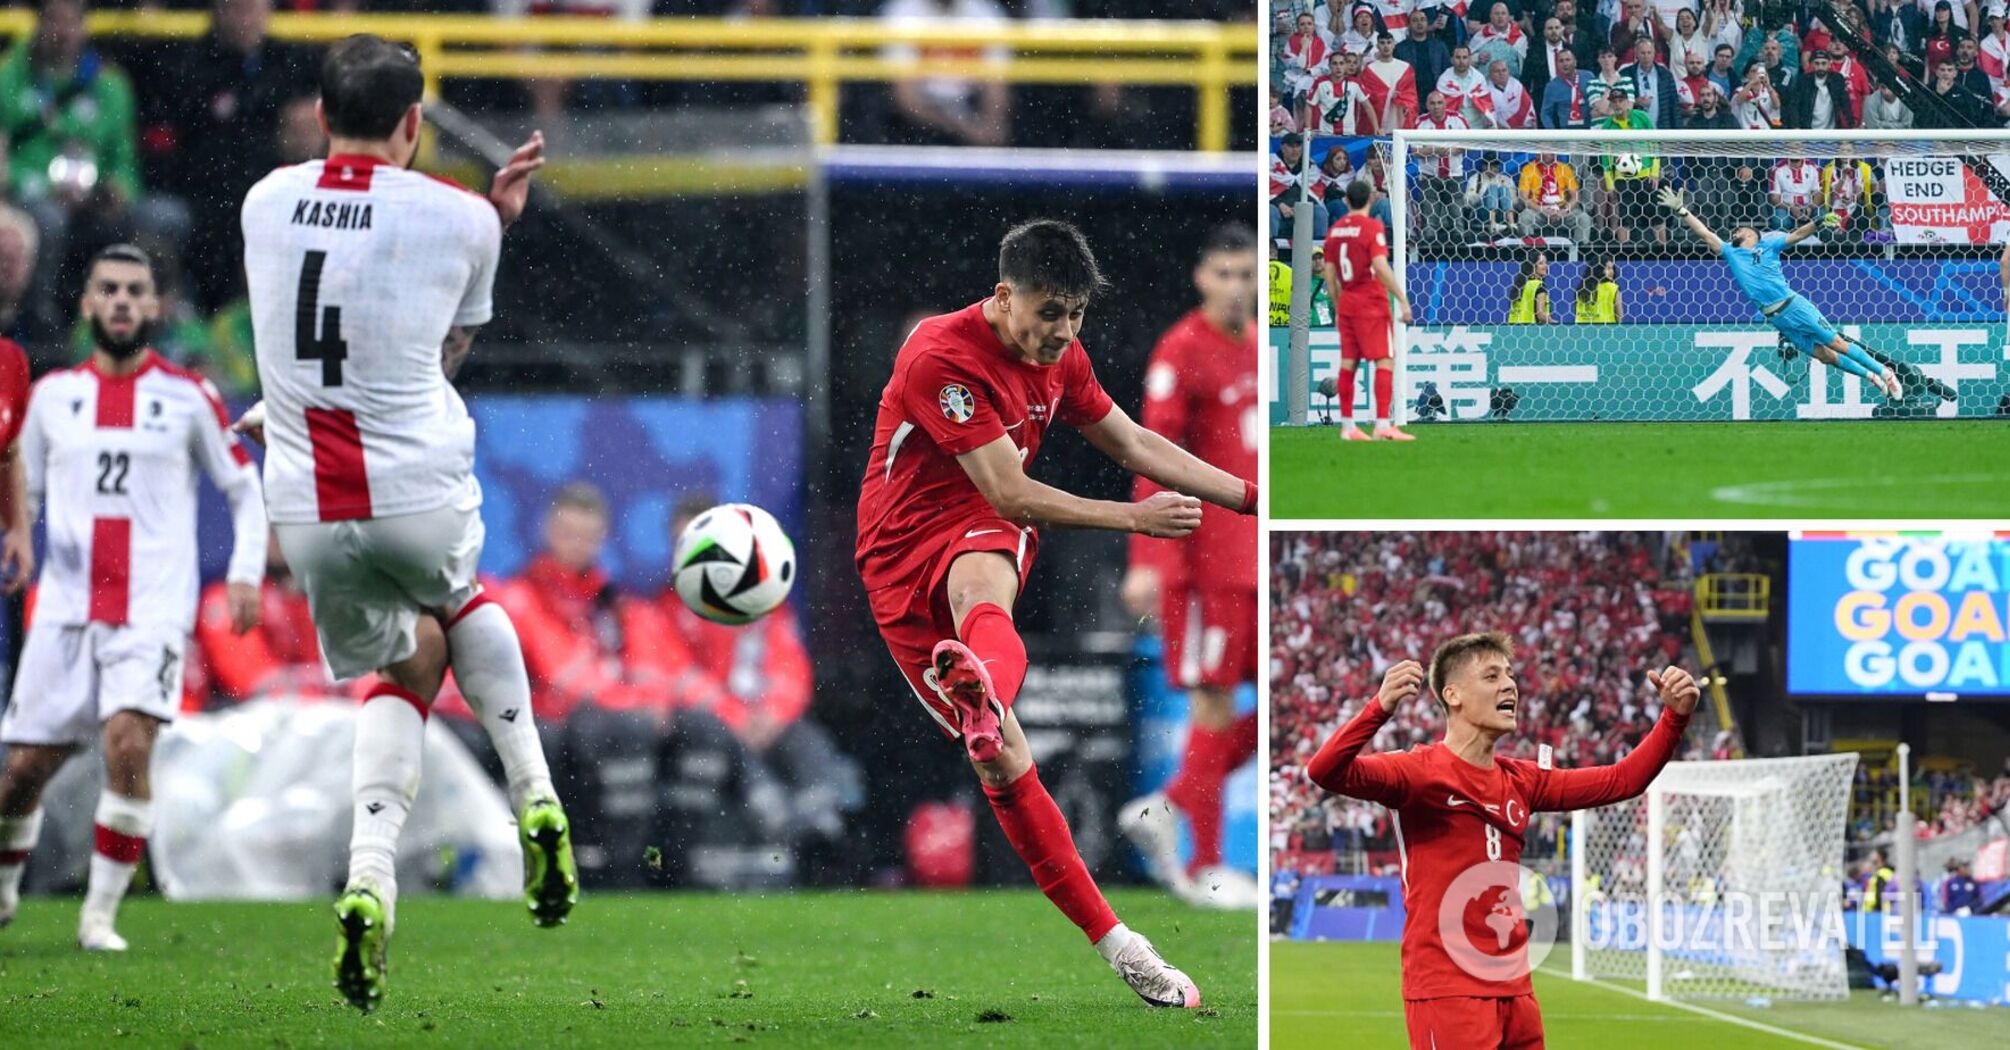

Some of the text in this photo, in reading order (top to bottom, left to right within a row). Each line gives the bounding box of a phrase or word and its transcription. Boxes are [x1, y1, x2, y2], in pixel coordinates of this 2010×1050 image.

[1890, 161, 1956, 177] HEDGE
[1904, 182, 1944, 198] END
[291, 199, 374, 231] KASHIA
[1339, 242, 1353, 281] 6
[295, 250, 348, 388] 4
[97, 450, 130, 495] 22
[1845, 540, 2010, 592] GOA
[1834, 590, 2010, 642] GOA
[1844, 640, 2010, 688] GOA
[1484, 823, 1502, 862] 8
